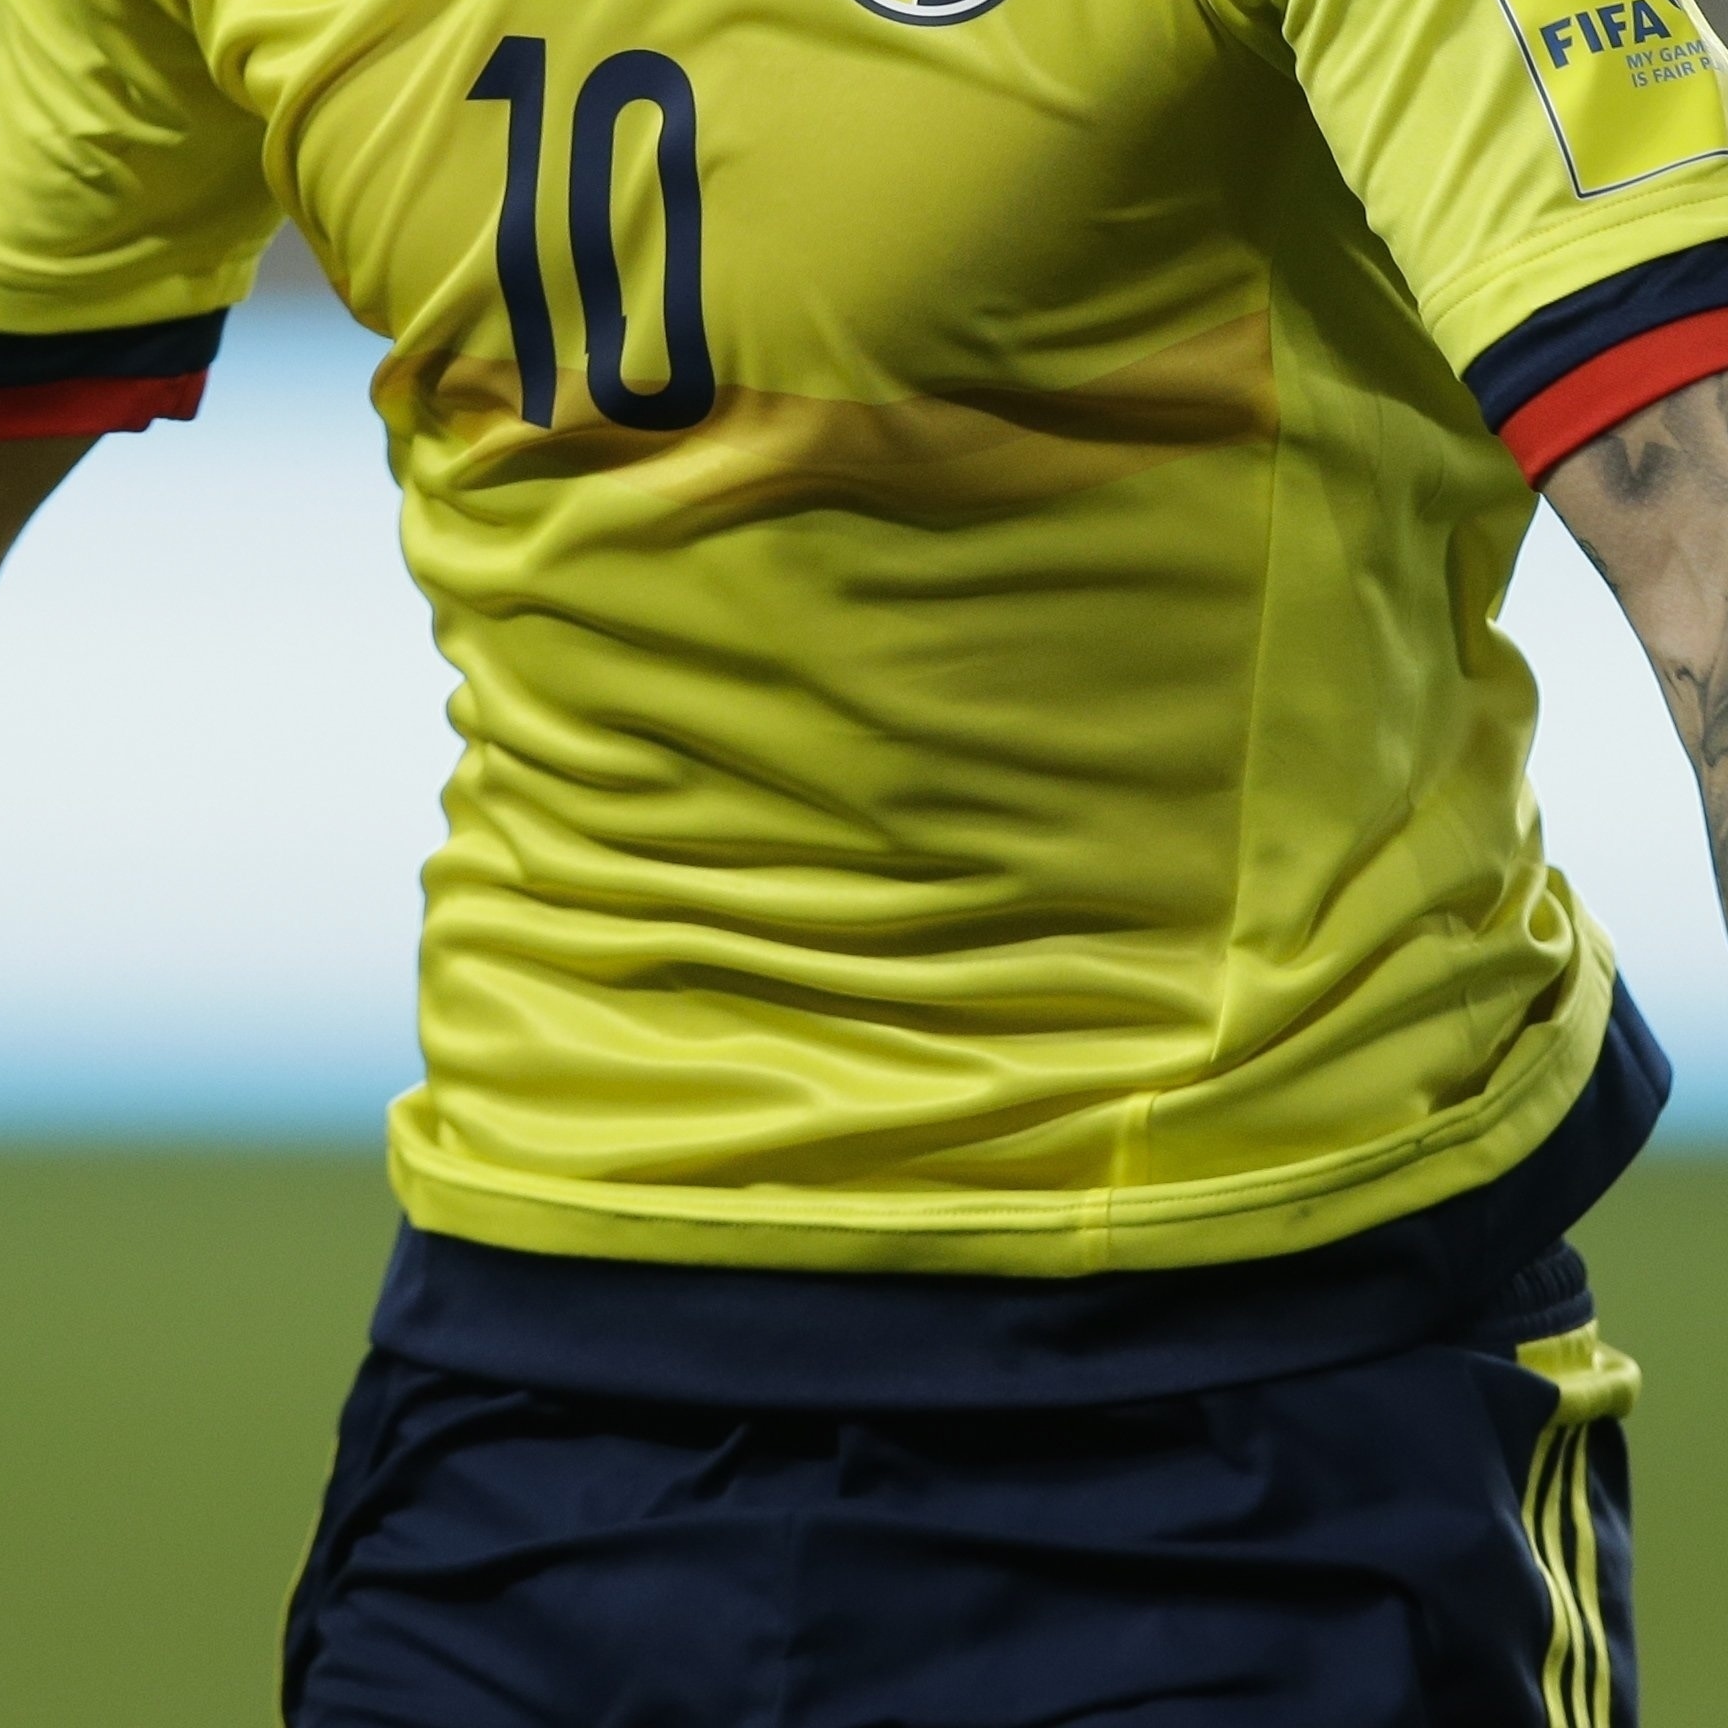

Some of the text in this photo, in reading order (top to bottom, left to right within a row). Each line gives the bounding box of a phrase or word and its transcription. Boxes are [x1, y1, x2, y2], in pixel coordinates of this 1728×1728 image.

[1626, 40, 1706, 69] MY GAM
[1631, 72, 1647, 88] IS
[1653, 61, 1695, 83] FAIR
[466, 35, 716, 431] 10
